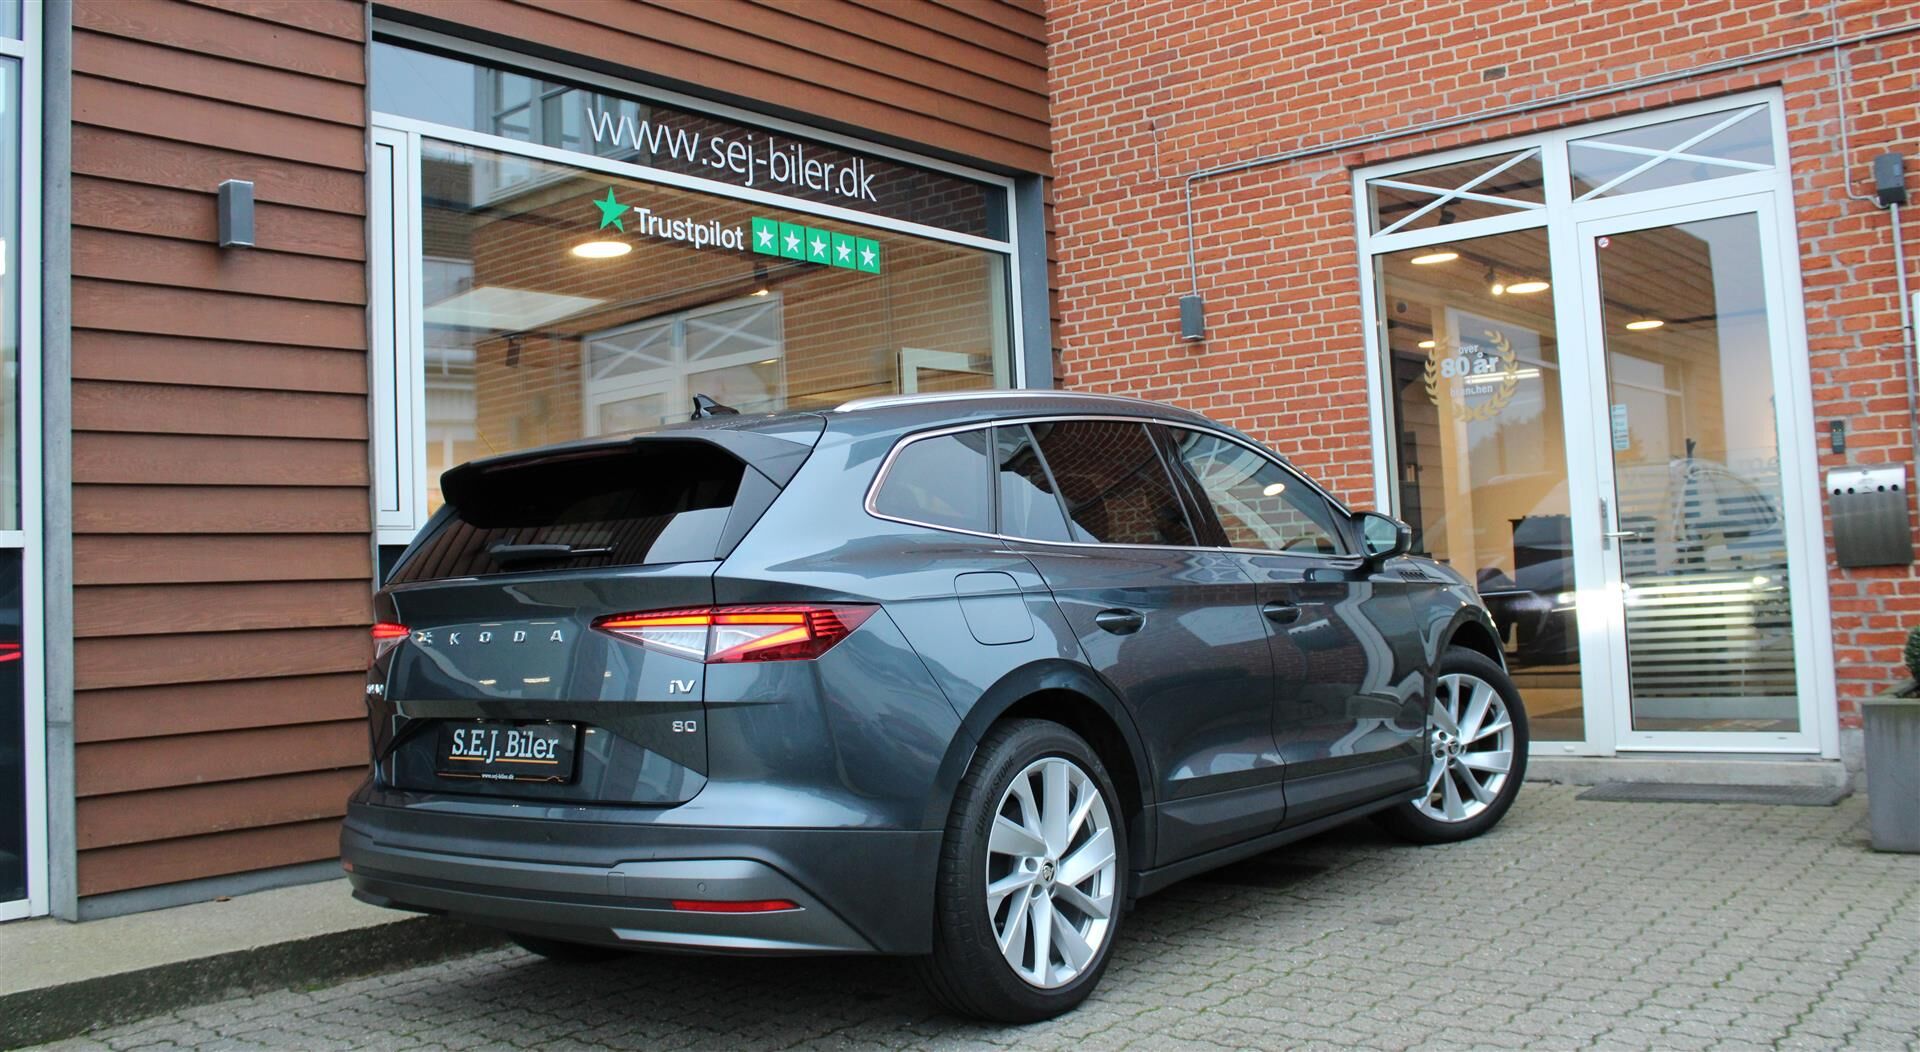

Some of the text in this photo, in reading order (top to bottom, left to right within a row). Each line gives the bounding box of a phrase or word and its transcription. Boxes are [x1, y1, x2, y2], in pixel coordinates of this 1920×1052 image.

[587, 107, 877, 202] www.sej-biler.dk
[633, 206, 744, 251] Trustpilot
[1441, 351, 1498, 378] 80 år
[1458, 344, 1479, 354] over
[672, 720, 697, 732] 80
[451, 728, 559, 764] S.E.J. Biler
